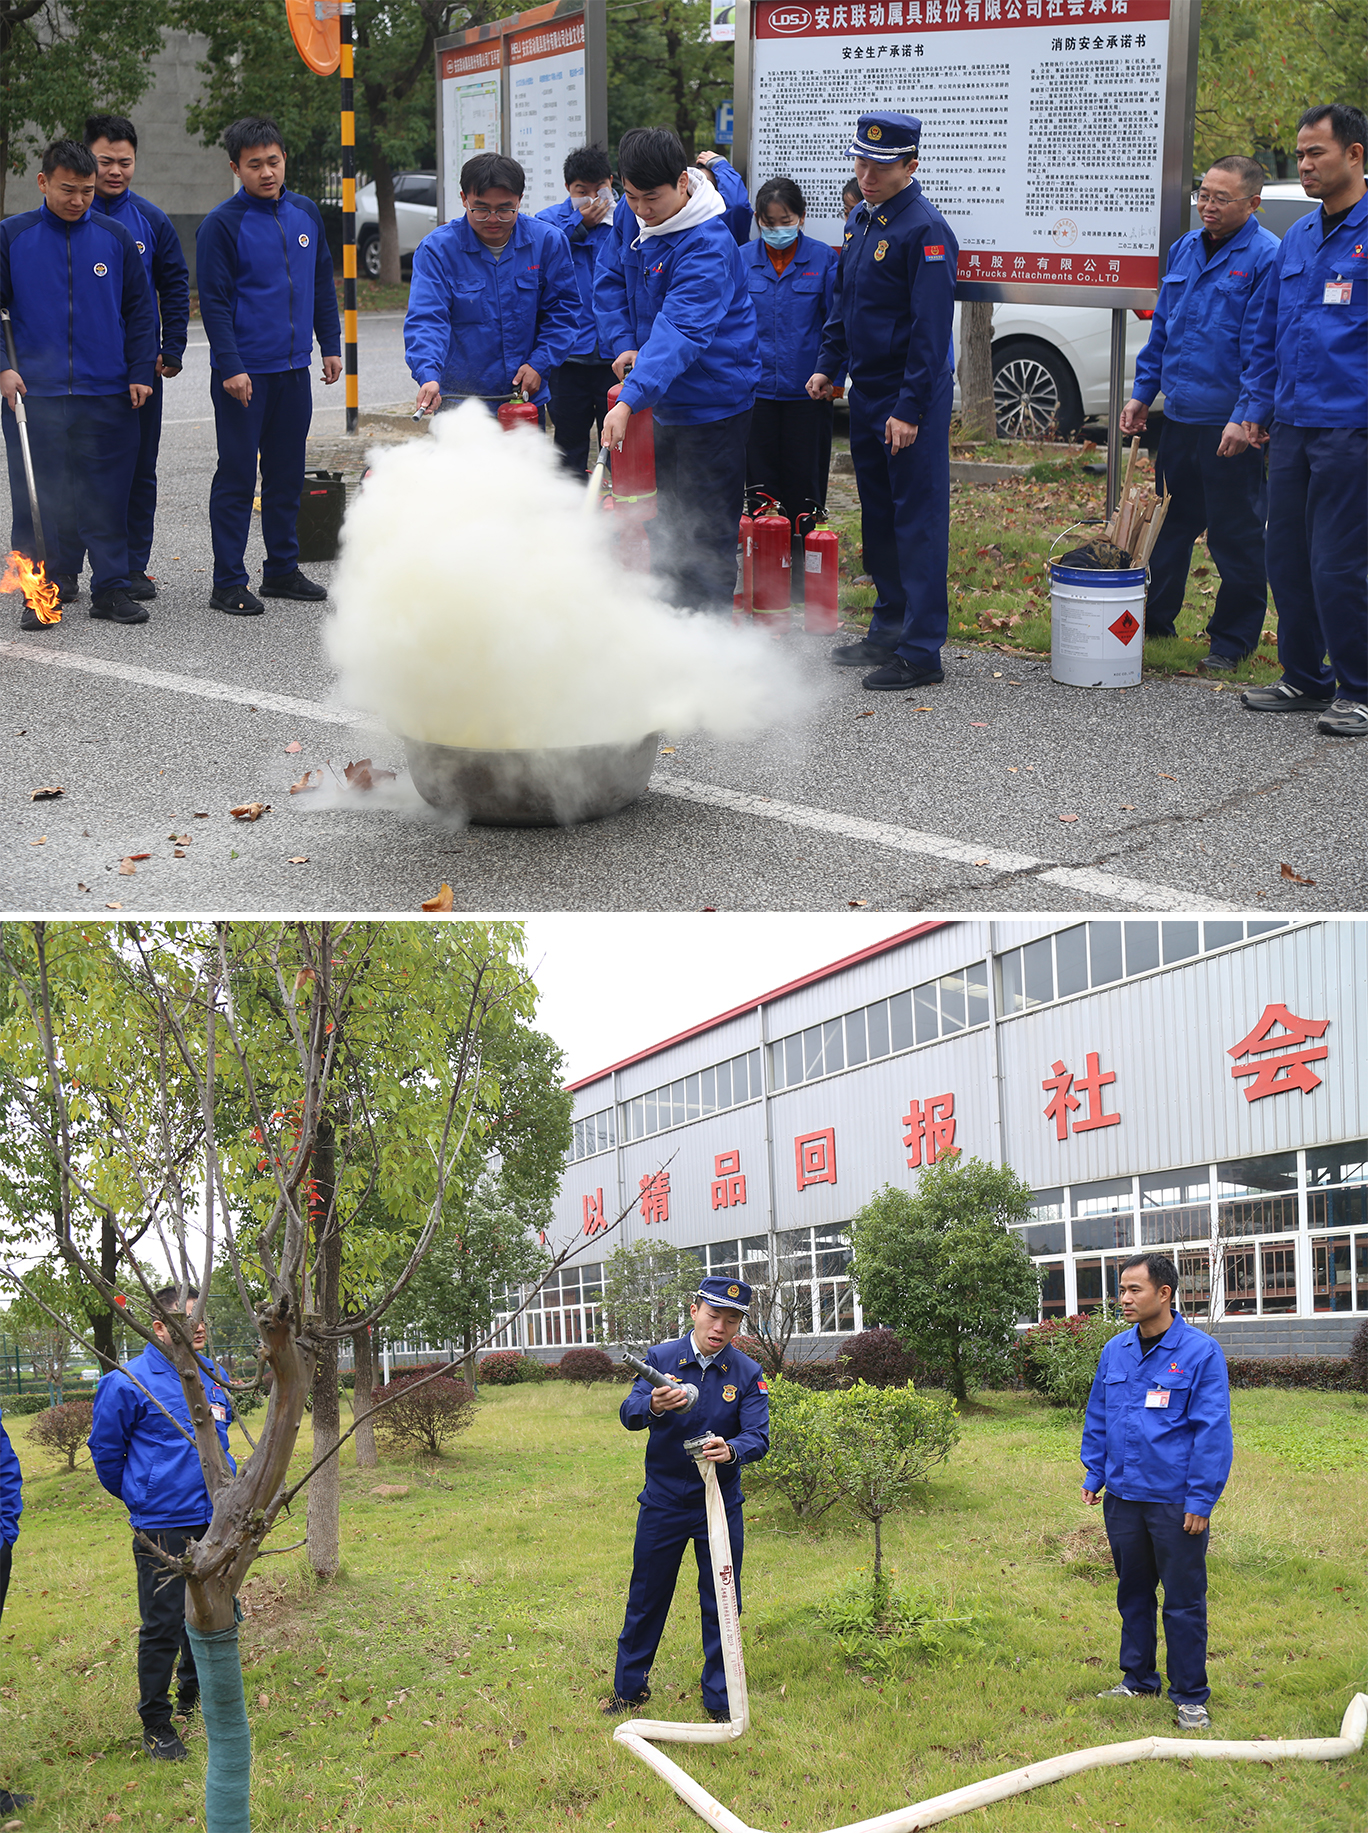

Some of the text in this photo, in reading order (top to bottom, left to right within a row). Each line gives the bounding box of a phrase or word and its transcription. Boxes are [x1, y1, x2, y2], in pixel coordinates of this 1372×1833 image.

[771, 13, 808, 26] LDSJ
[1051, 34, 1147, 51] 消防安全承诺书
[842, 44, 924, 60] 安全生产承诺书
[975, 269, 1007, 278] Trucks
[1011, 271, 1073, 281] Attachments
[582, 1003, 1331, 1235] 以精品回报社会
